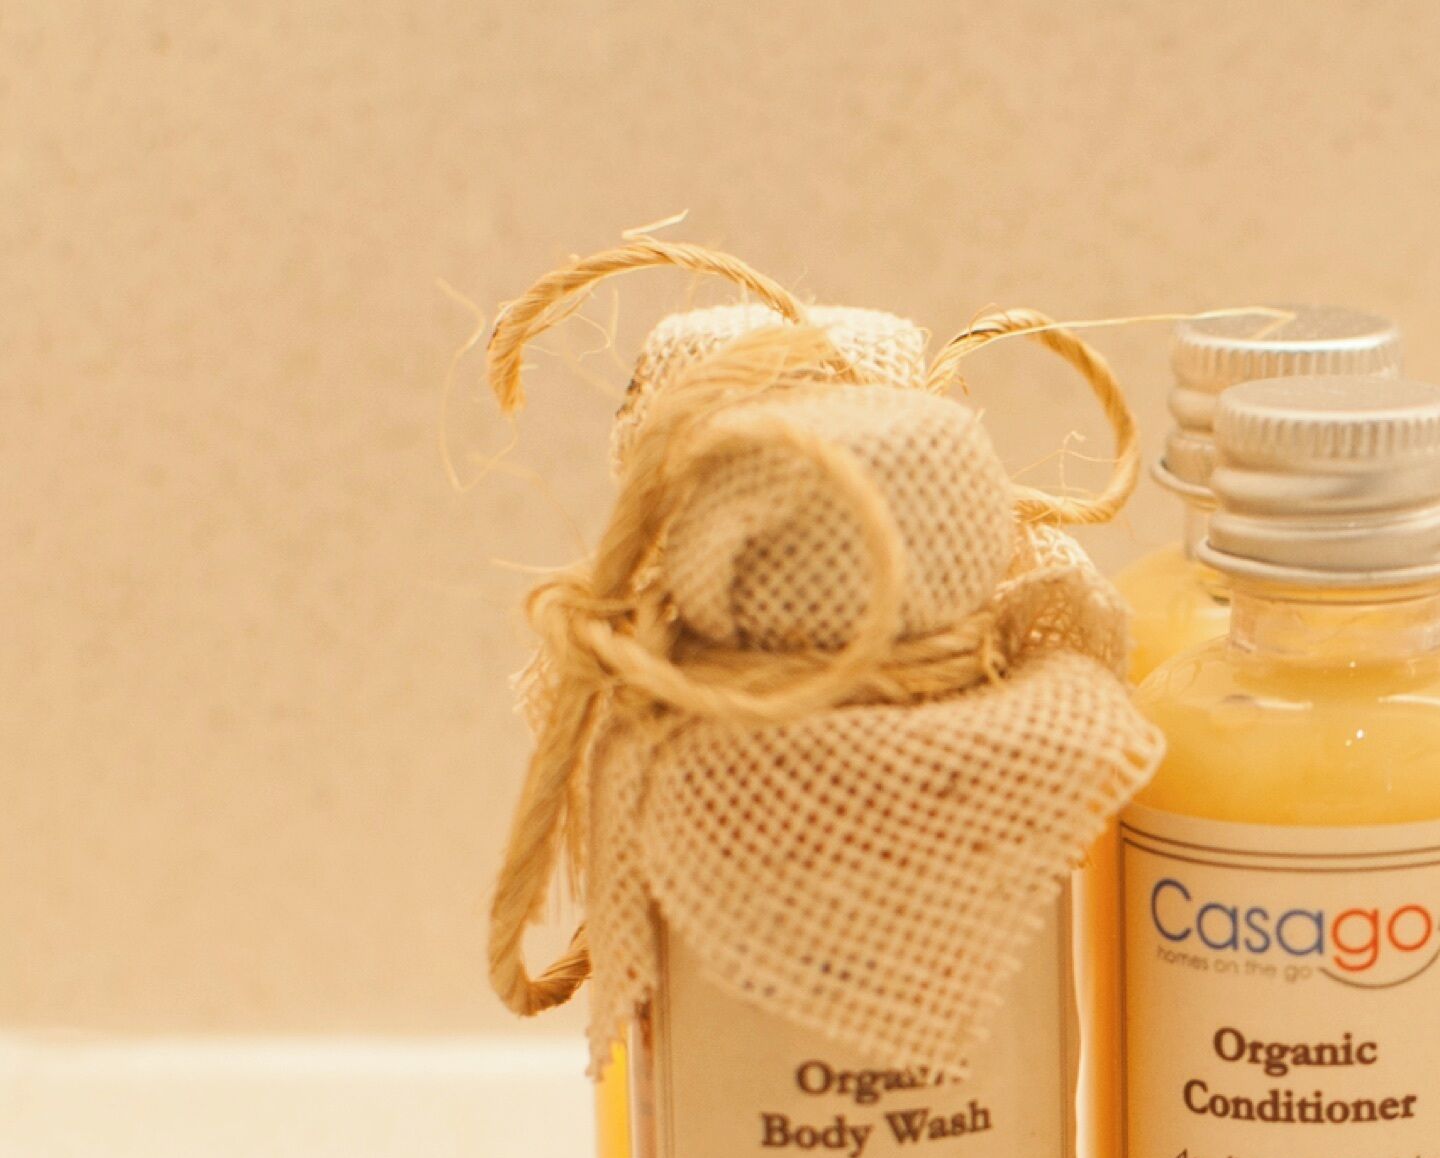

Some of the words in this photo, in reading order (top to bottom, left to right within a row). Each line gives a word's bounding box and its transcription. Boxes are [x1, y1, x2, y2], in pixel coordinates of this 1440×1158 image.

[1151, 878, 1433, 973] Casago
[1157, 945, 1209, 971] homes
[1214, 958, 1240, 975] on
[1245, 960, 1277, 978] the
[1284, 964, 1313, 983] go
[1213, 1026, 1378, 1078] Organic
[1183, 1078, 1418, 1125] Conditioner
[761, 1111, 873, 1158] Body
[884, 1099, 993, 1144] Wash
